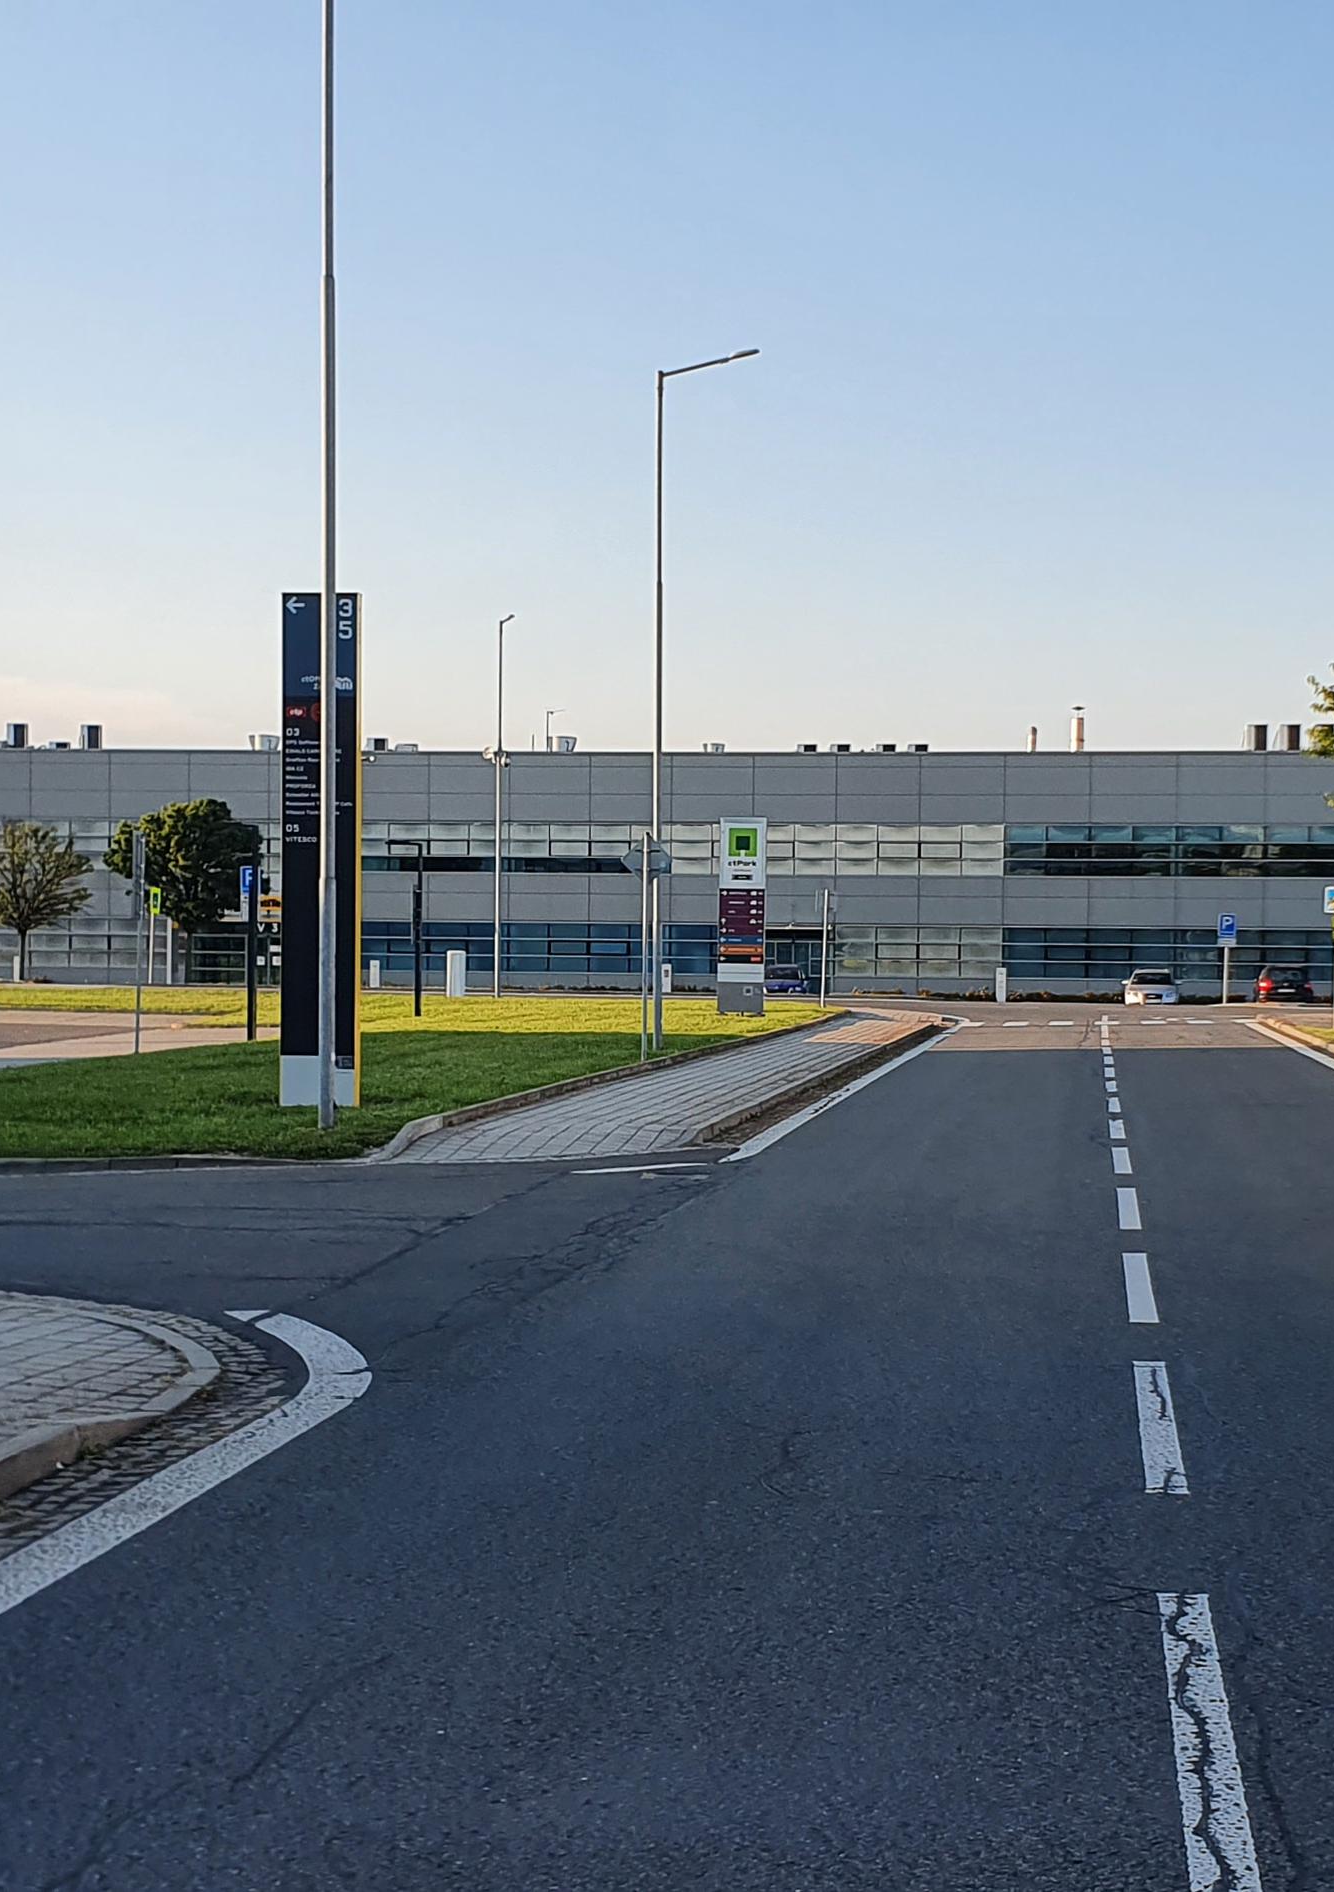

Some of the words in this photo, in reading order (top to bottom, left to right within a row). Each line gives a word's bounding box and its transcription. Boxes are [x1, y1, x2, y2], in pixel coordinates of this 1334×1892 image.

[338, 598, 353, 617] 3
[338, 620, 353, 639] 5
[285, 727, 300, 737] 03
[285, 823, 300, 833] 05
[1222, 916, 1233, 930] P
